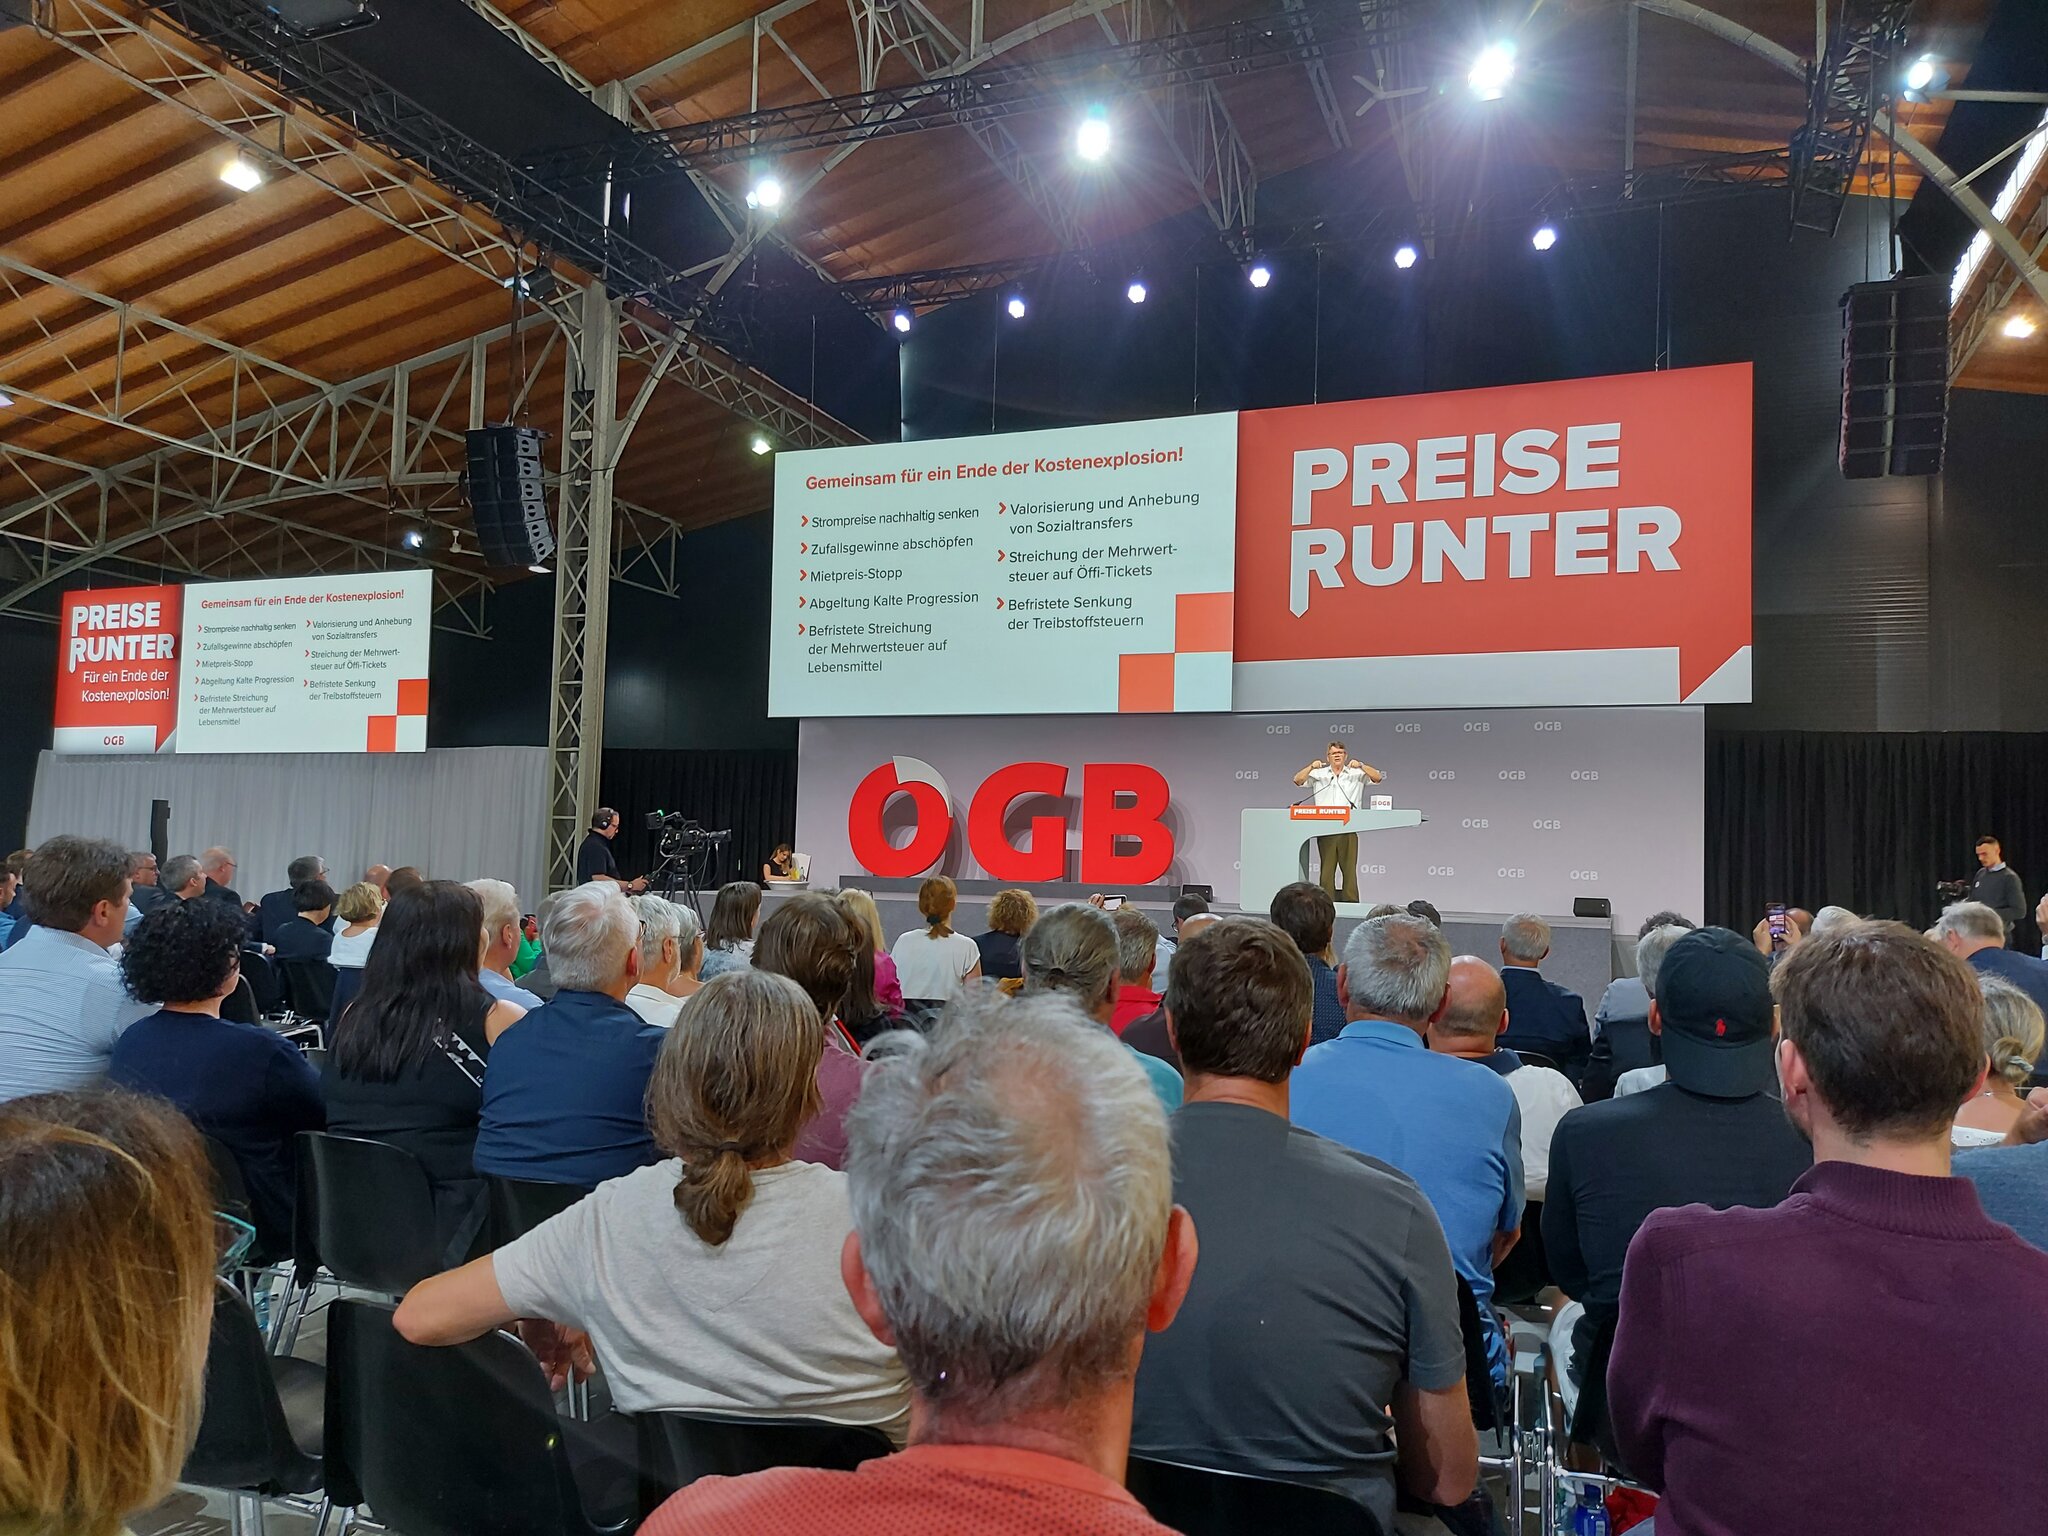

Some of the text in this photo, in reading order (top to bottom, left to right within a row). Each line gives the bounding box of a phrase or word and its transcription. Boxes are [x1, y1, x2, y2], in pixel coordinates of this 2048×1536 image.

[805, 446, 1183, 490] Gemeinsam für ein Ende der Kostenexplosion!
[1291, 422, 1622, 526] PREISE
[1010, 493, 1199, 515] Valorisierung und Anhebung
[811, 507, 979, 528] Strompreise nachhaltig senken
[1009, 516, 1133, 534] von Sozialtransfers
[811, 535, 973, 555] Zufallsgewinne abschöpfen
[1009, 543, 1177, 563] Streichung der Mehrwert-
[1289, 505, 1682, 618] RUNTER
[810, 567, 902, 583] Mietpreis-Stopp
[1008, 564, 1152, 582] steuer auf Öffi-Tickets
[201, 589, 404, 609] Gemeinsam für ein Ende der Kostenexplosion!
[809, 591, 978, 611] Abgeltung Kalte Progression
[1008, 595, 1132, 611] Befristete Senkung
[71, 601, 161, 637] PREISE
[311, 617, 412, 628] Valorisierung und Anhebung
[1007, 615, 1143, 630] der Treibstoffsteuern
[203, 622, 296, 634] Strompreise nachhaltig senken
[326, 630, 378, 640] Sozialtransfers
[809, 622, 931, 636] Befristete Streichung
[69, 632, 175, 674] RUNTER
[202, 639, 292, 652] Zufallsgewinne abschöpfen
[311, 648, 400, 659] Streichung der Mehrwert-
[808, 639, 947, 655] der Mehrwertsteuer auf
[201, 659, 253, 669] Mietpreis-Stopp
[333, 661, 345, 670] auf
[808, 660, 882, 673] Lebensmittel
[83, 668, 169, 684] Für ein Ende der
[200, 675, 294, 687] Abgeltung Kalte Progression
[309, 679, 376, 689] Befristete Senkung
[81, 687, 171, 703] Kostenexplosion!
[199, 693, 268, 703] Befristete Streichung
[322, 691, 381, 700] Treibstoffsteuern
[211, 706, 264, 714] Mehrwertsteuer
[264, 704, 276, 713] auf
[198, 717, 240, 726] Lebensmittel
[1294, 808, 1317, 816] PREISE
